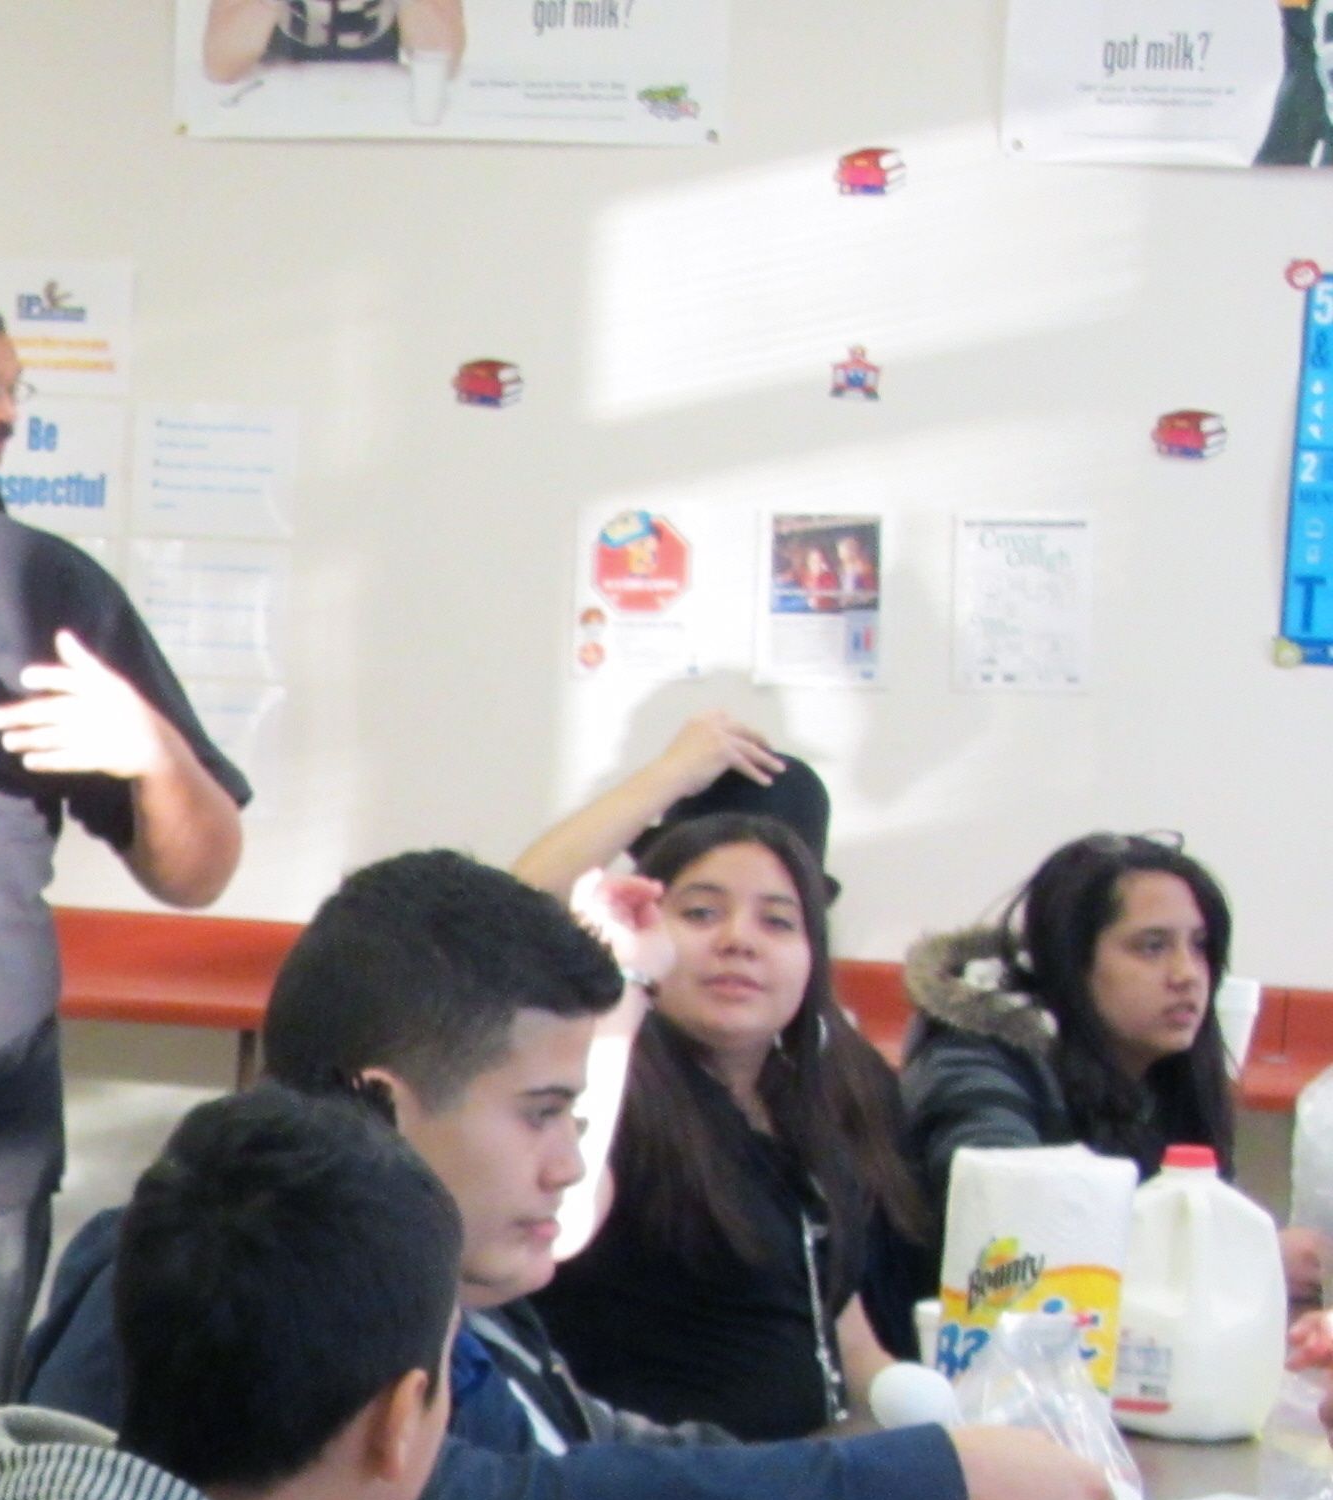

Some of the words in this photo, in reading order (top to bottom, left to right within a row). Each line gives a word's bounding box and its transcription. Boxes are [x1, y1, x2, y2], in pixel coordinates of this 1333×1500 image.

[1102, 34, 1138, 75] got
[1145, 31, 1213, 72] milk?
[28, 416, 58, 451] Be
[967, 1253, 1045, 1315] Bounty
